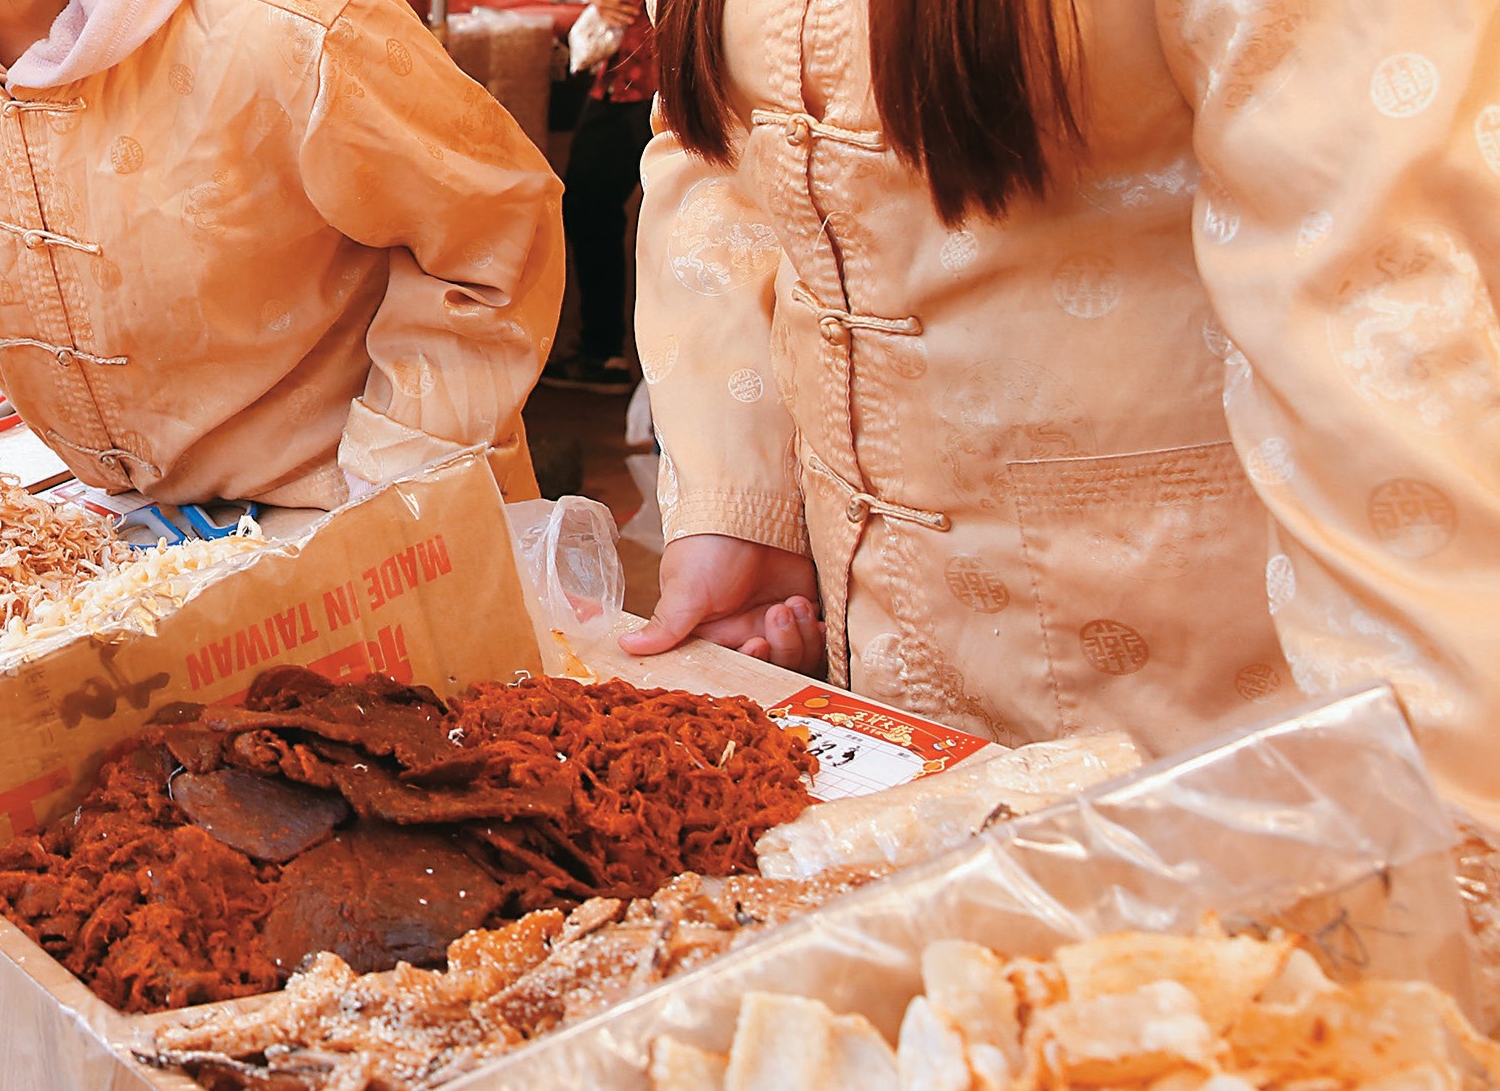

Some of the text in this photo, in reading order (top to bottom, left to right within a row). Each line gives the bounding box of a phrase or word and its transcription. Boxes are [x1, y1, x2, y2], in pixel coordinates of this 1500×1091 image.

[322, 580, 362, 632] IN
[362, 534, 453, 611] MADE
[185, 602, 319, 691] TAIWAN
